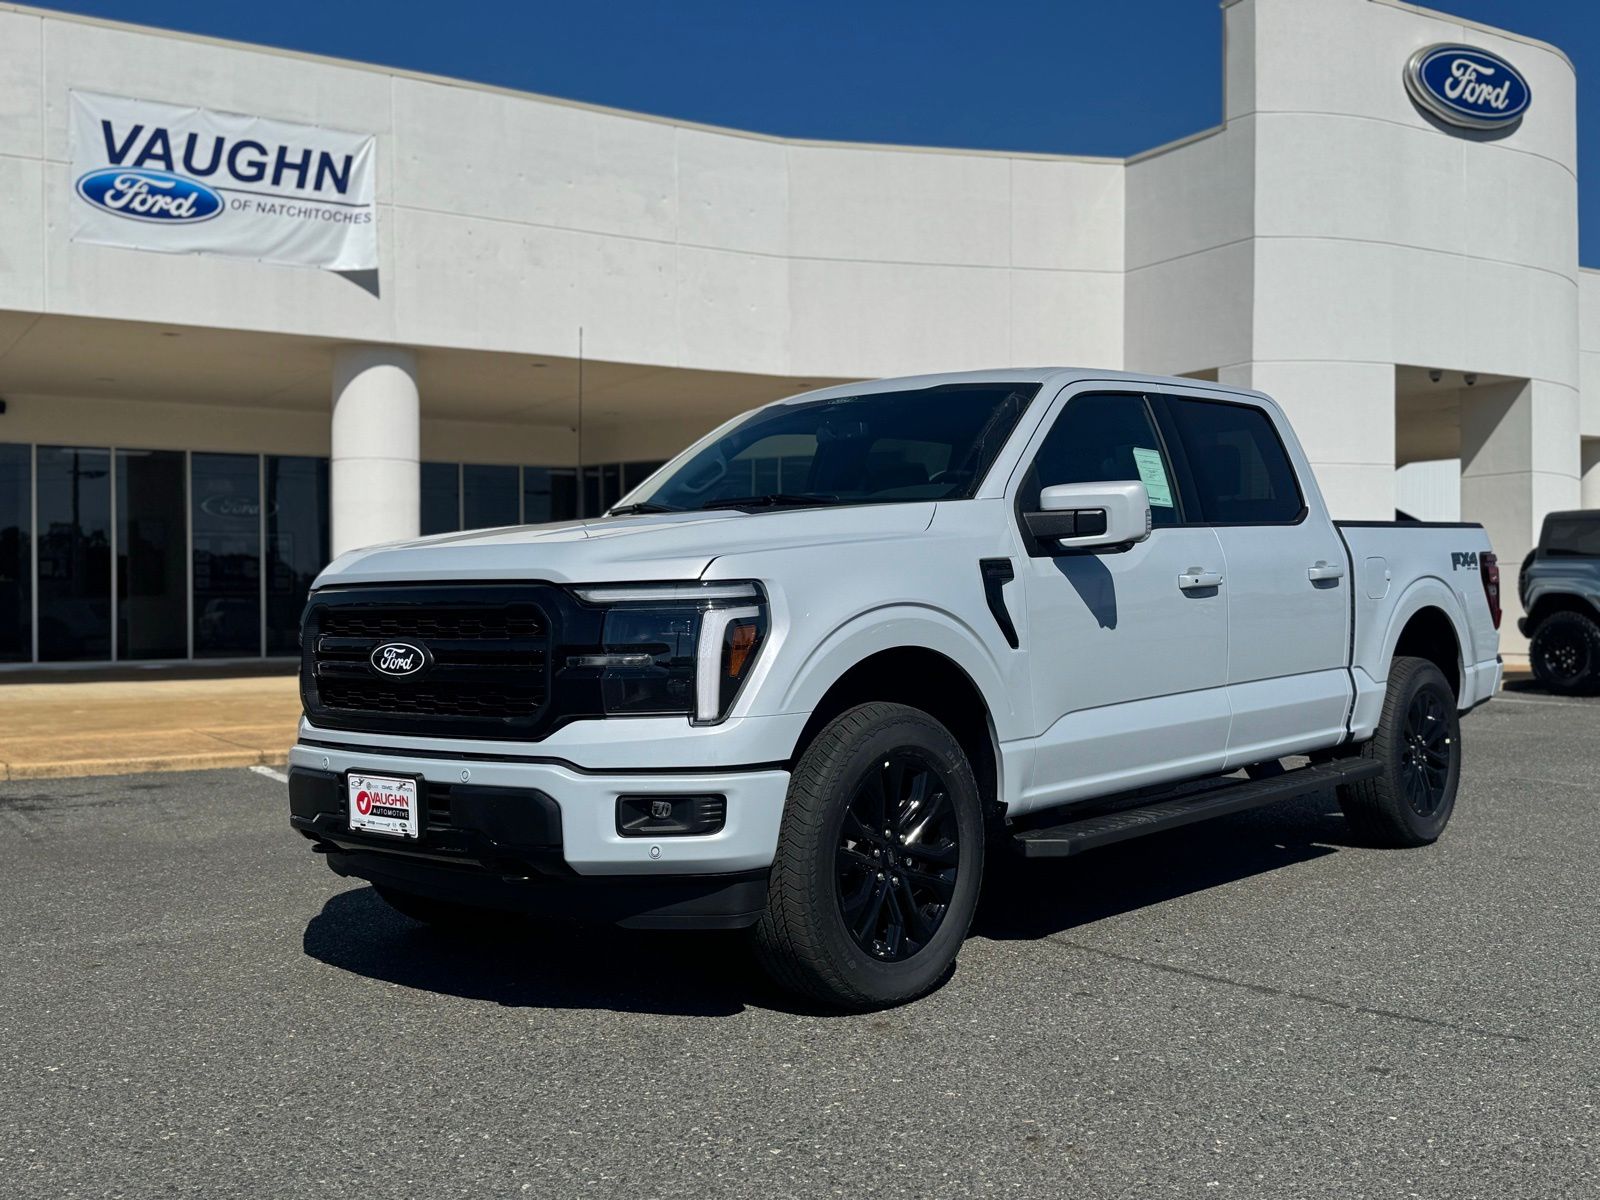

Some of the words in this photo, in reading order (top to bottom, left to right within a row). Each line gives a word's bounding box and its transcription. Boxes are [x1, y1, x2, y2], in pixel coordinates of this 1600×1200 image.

[1444, 59, 1510, 110] Ford
[101, 119, 353, 194] VAUGHN
[103, 174, 198, 218] Ford
[230, 198, 251, 211] OF
[256, 202, 372, 224] NATCHITOCHES
[1451, 551, 1478, 571] FX4
[381, 647, 414, 670] Ford
[369, 791, 409, 808] VAUGHN
[372, 808, 409, 819] AUTOMOTIVE
